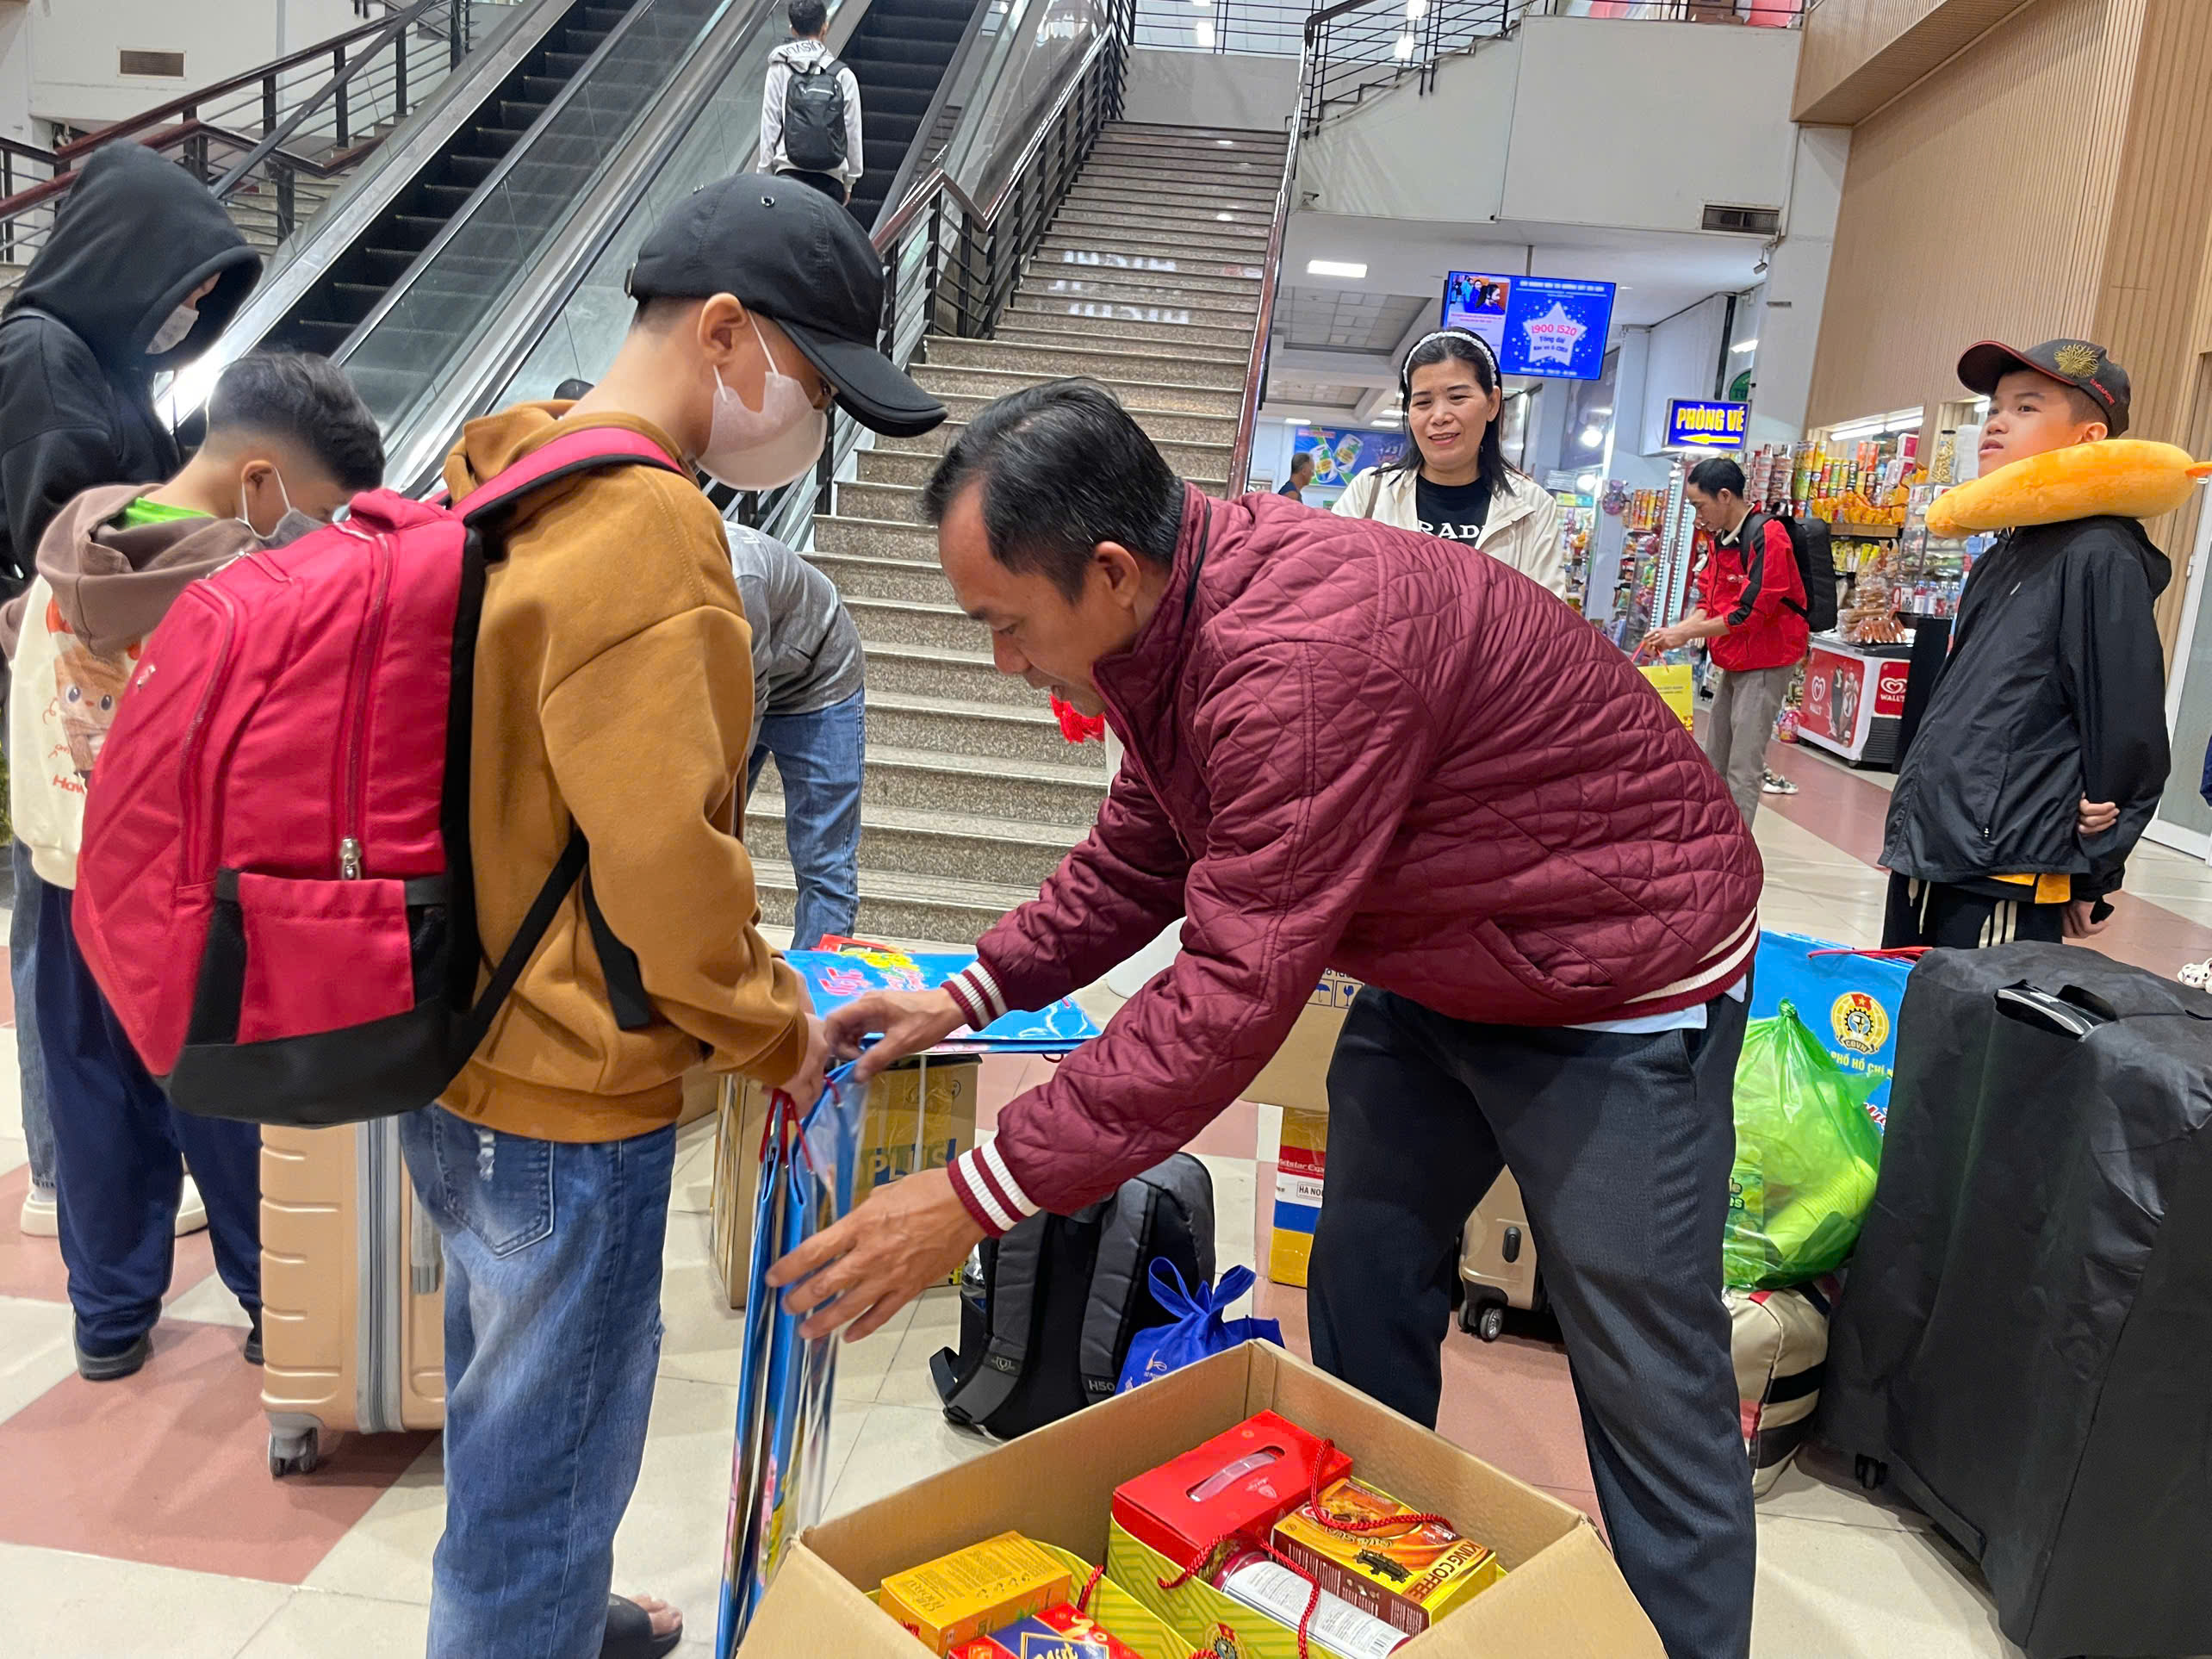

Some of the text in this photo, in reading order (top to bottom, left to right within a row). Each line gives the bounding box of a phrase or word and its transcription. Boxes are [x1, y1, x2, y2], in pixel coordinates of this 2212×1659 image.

[1676, 404, 1745, 432] PHÒNG VÉ
[1418, 520, 1485, 539] RAD
[1408, 1540, 1482, 1600] KING COFFEE
